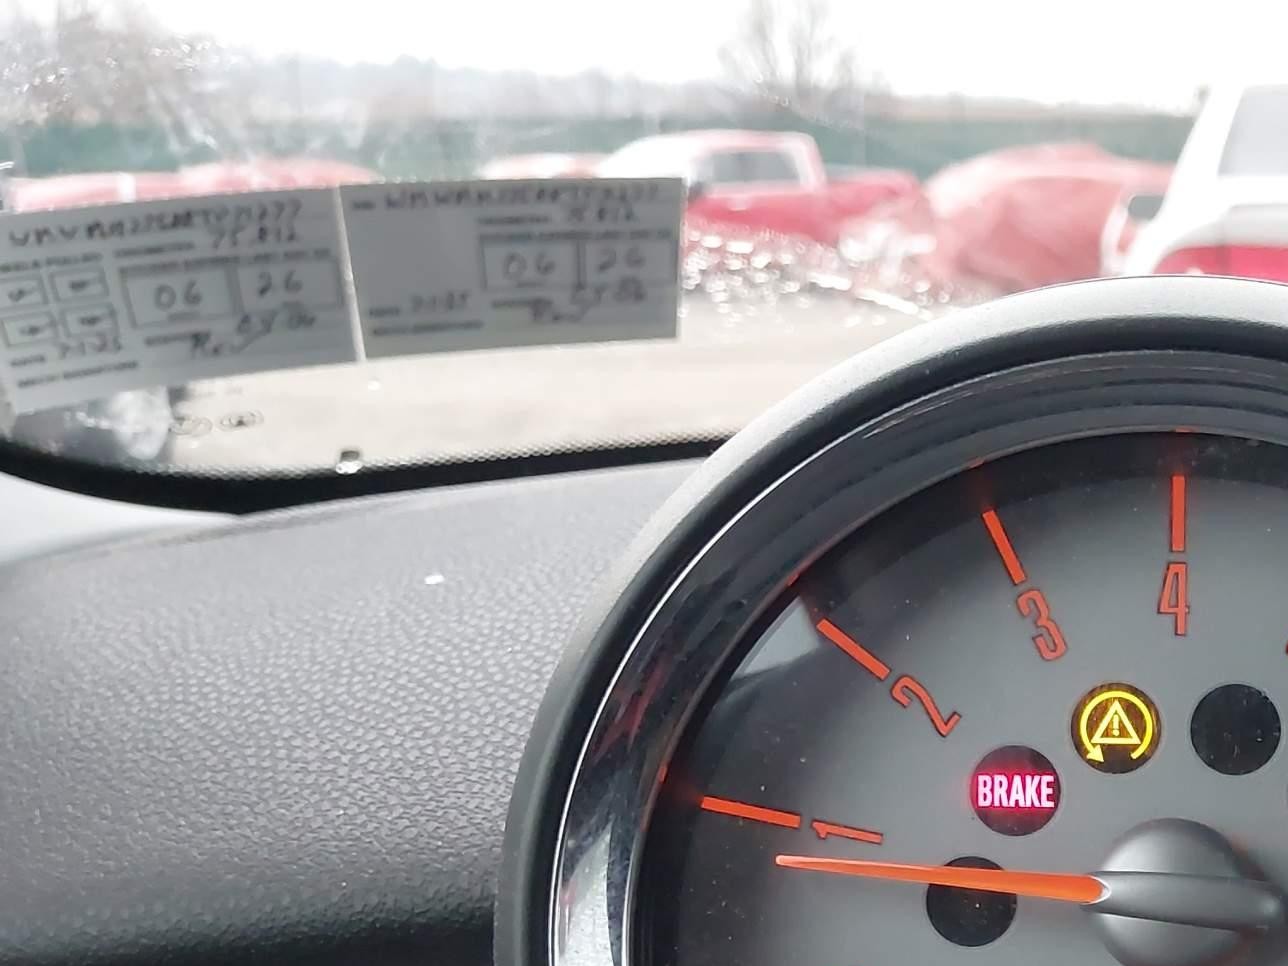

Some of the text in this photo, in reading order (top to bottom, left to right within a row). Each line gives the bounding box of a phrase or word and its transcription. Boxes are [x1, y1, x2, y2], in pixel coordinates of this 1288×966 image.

[1016, 588, 1068, 662] 3
[1157, 561, 1189, 637] 4
[889, 674, 963, 738] 2
[976, 774, 1055, 809] BRAKE
[811, 818, 884, 845] 1
